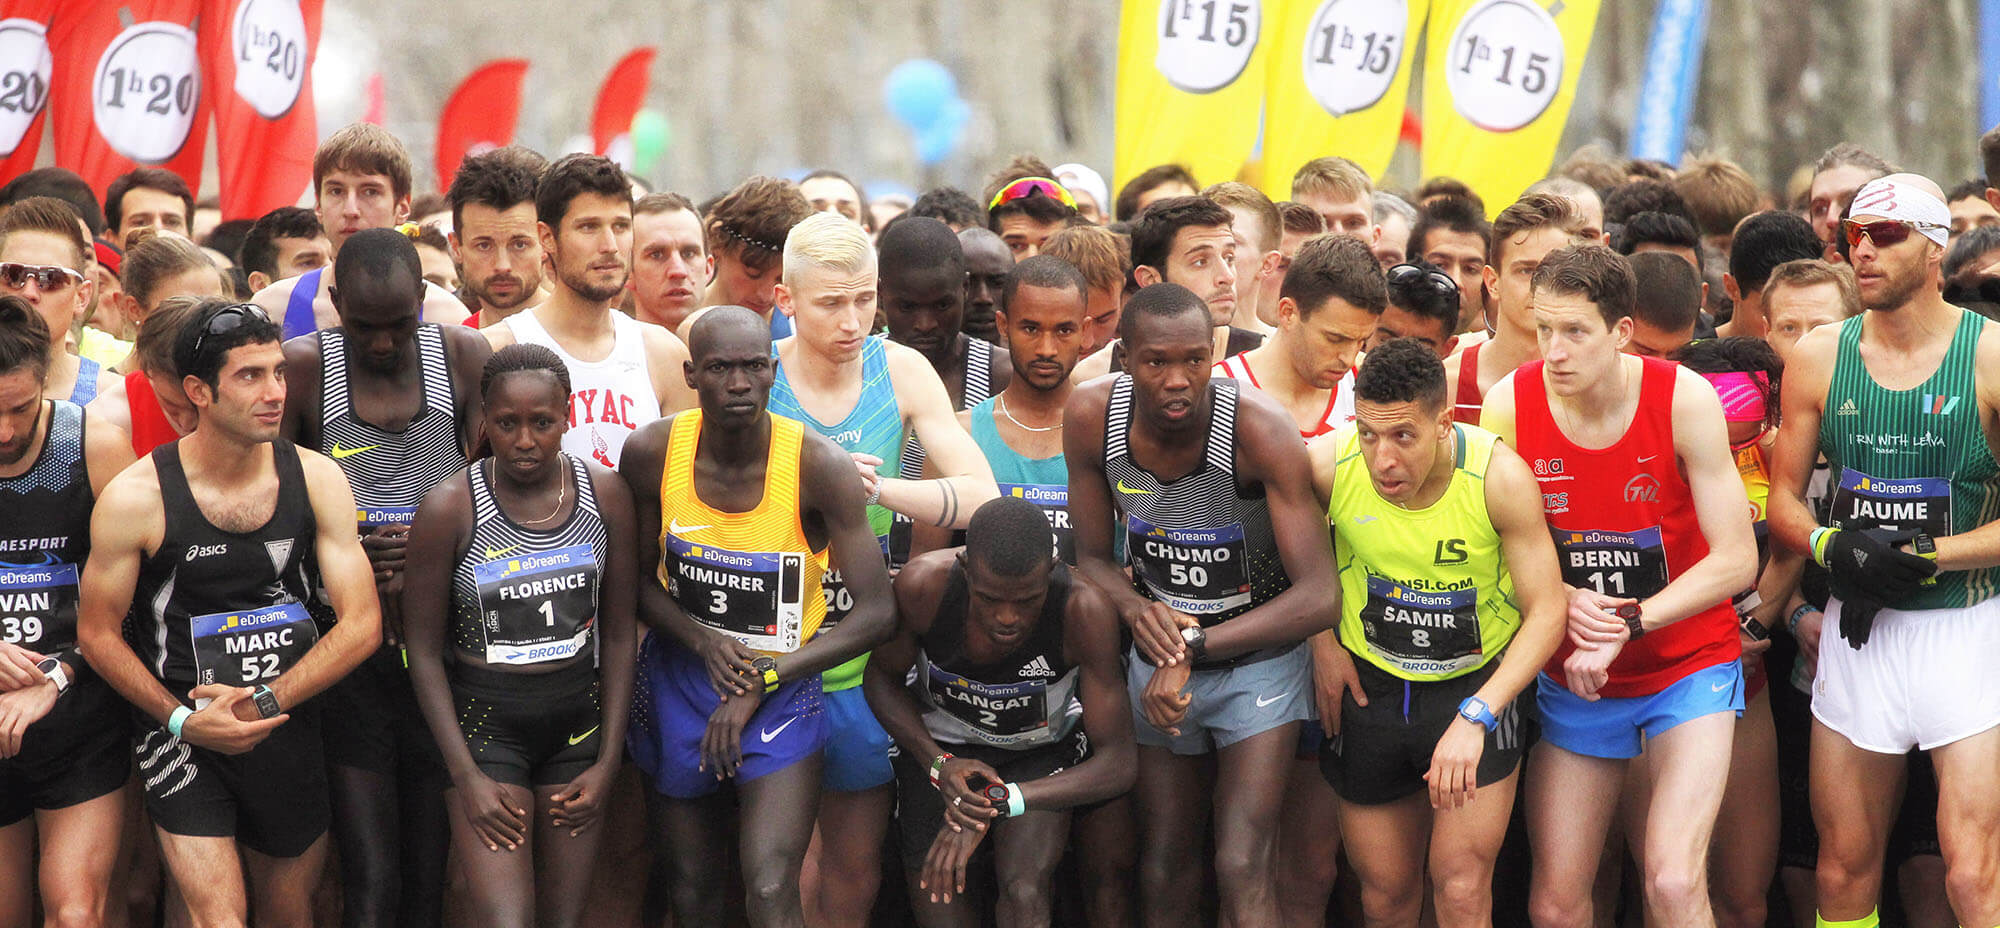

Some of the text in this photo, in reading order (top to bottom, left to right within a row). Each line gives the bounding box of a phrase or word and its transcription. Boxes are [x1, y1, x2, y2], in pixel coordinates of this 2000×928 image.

[1878, 433, 1908, 447] WITH
[1024, 488, 1068, 501] eDream
[1871, 481, 1922, 495] eDreams
[1850, 498, 1928, 521] JAUME
[1168, 531, 1217, 542] eDreams
[1585, 531, 1635, 546] eDreams
[521, 552, 570, 571] eDreams
[704, 550, 753, 567] eDreams
[1145, 541, 1231, 564] CHUMO
[1569, 550, 1641, 568] BERNI
[785, 557, 799, 568] 3
[0, 571, 52, 585] eDreams
[678, 561, 766, 593] KIMURER
[1170, 563, 1209, 588] 50
[1587, 571, 1626, 595] 11
[499, 572, 587, 601] FLORENCE
[0, 592, 49, 612] VAN
[709, 590, 728, 615] 3
[1171, 600, 1225, 612] BROOKS
[1402, 592, 1452, 606] eDreams
[240, 609, 289, 627] eDreams
[537, 599, 557, 628] 1
[1383, 605, 1457, 629] SAMIR
[2, 616, 43, 643] 39
[1411, 629, 1431, 648] 8
[225, 628, 294, 655] MARC
[527, 642, 578, 661] BROOKS
[241, 653, 281, 682] 52
[1018, 667, 1056, 677] adidas
[1402, 661, 1457, 671] BROOKS
[945, 686, 1032, 711] LANGAT
[970, 683, 1019, 696] eDreams
[979, 710, 998, 727] 2
